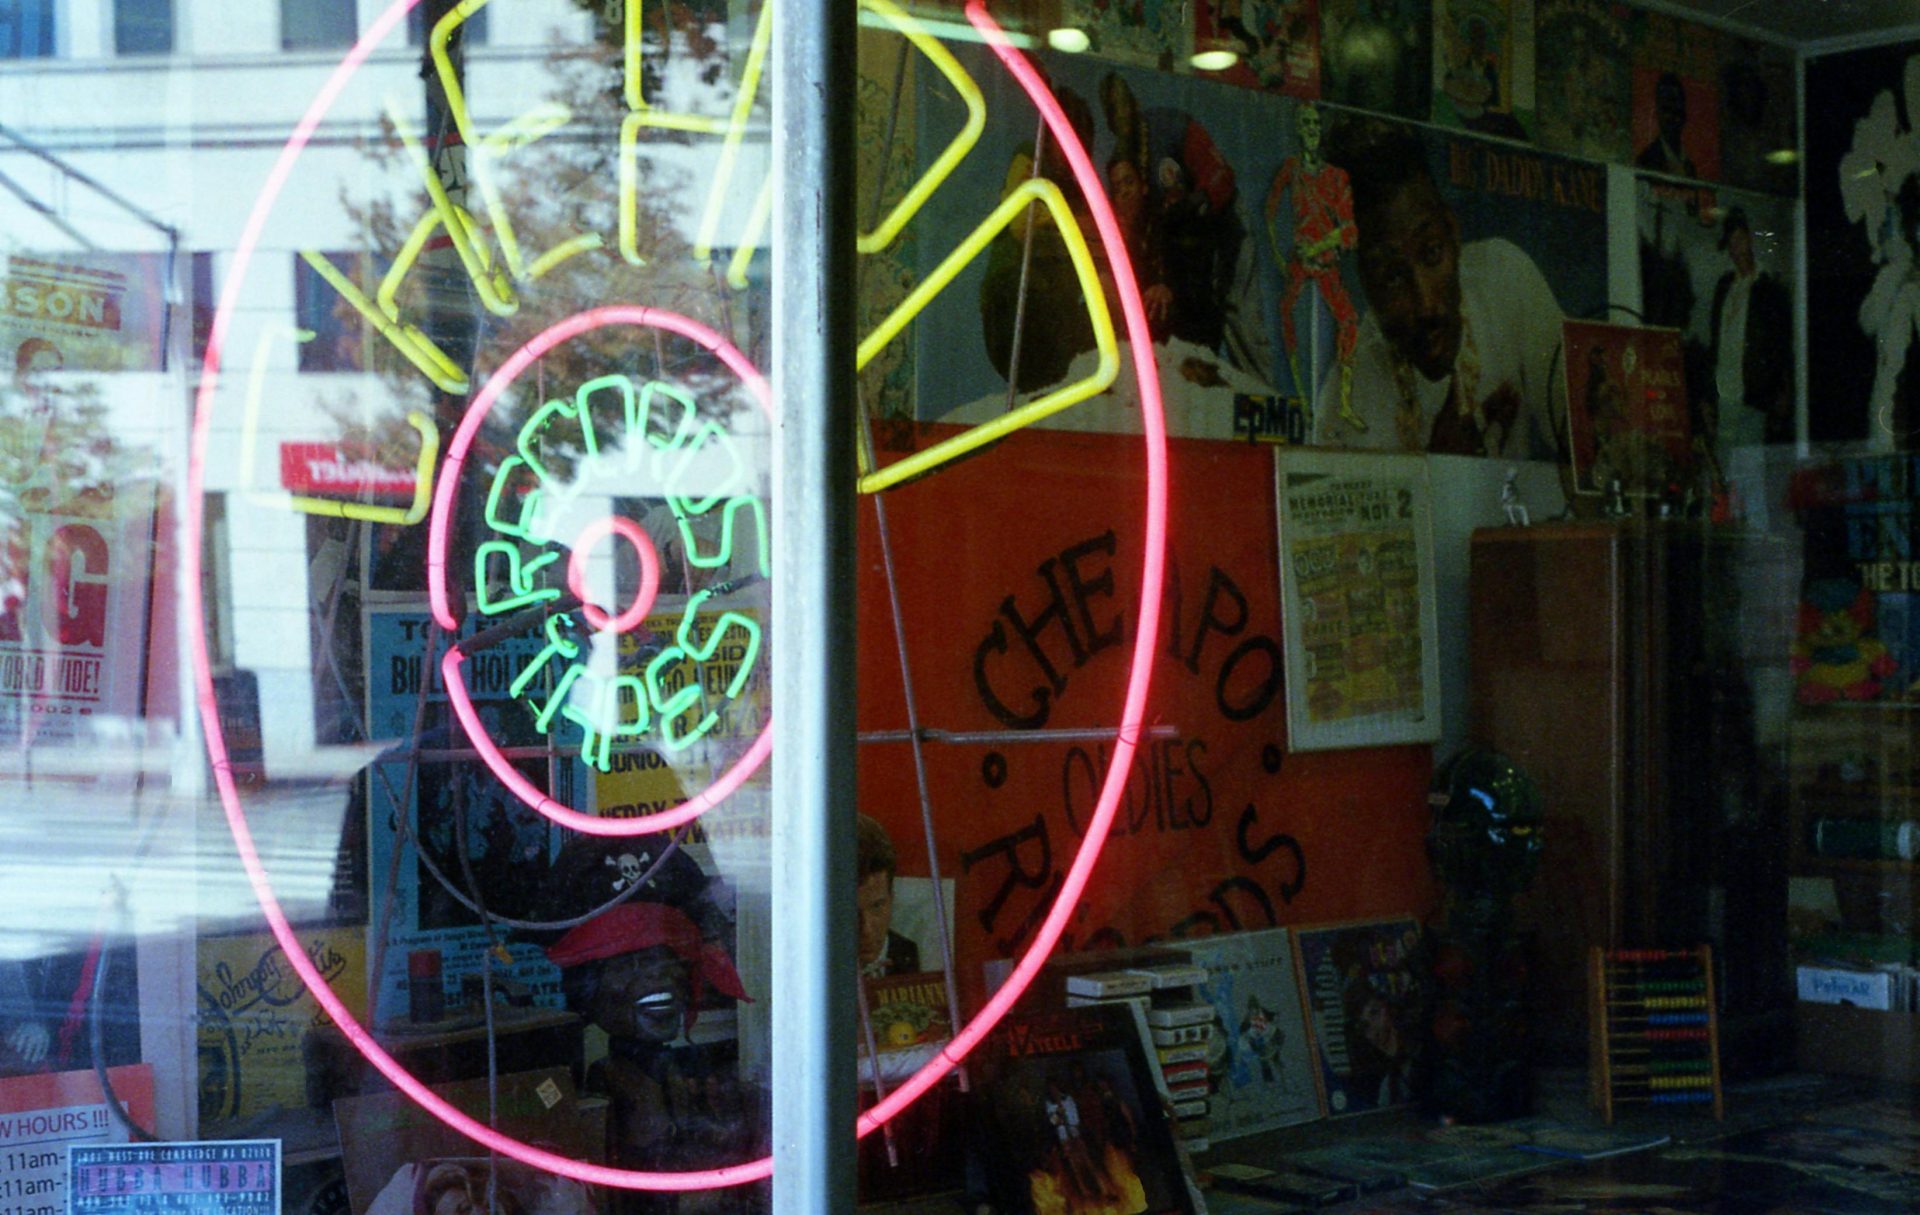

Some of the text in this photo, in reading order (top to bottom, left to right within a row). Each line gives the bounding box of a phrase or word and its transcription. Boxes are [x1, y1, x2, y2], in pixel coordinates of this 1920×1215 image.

[0, 284, 105, 324] SON
[17, 1111, 88, 1136] HOURS
[8, 1151, 66, 1171] 11am-
[80, 1163, 266, 1193] HUBBA HUBBA
